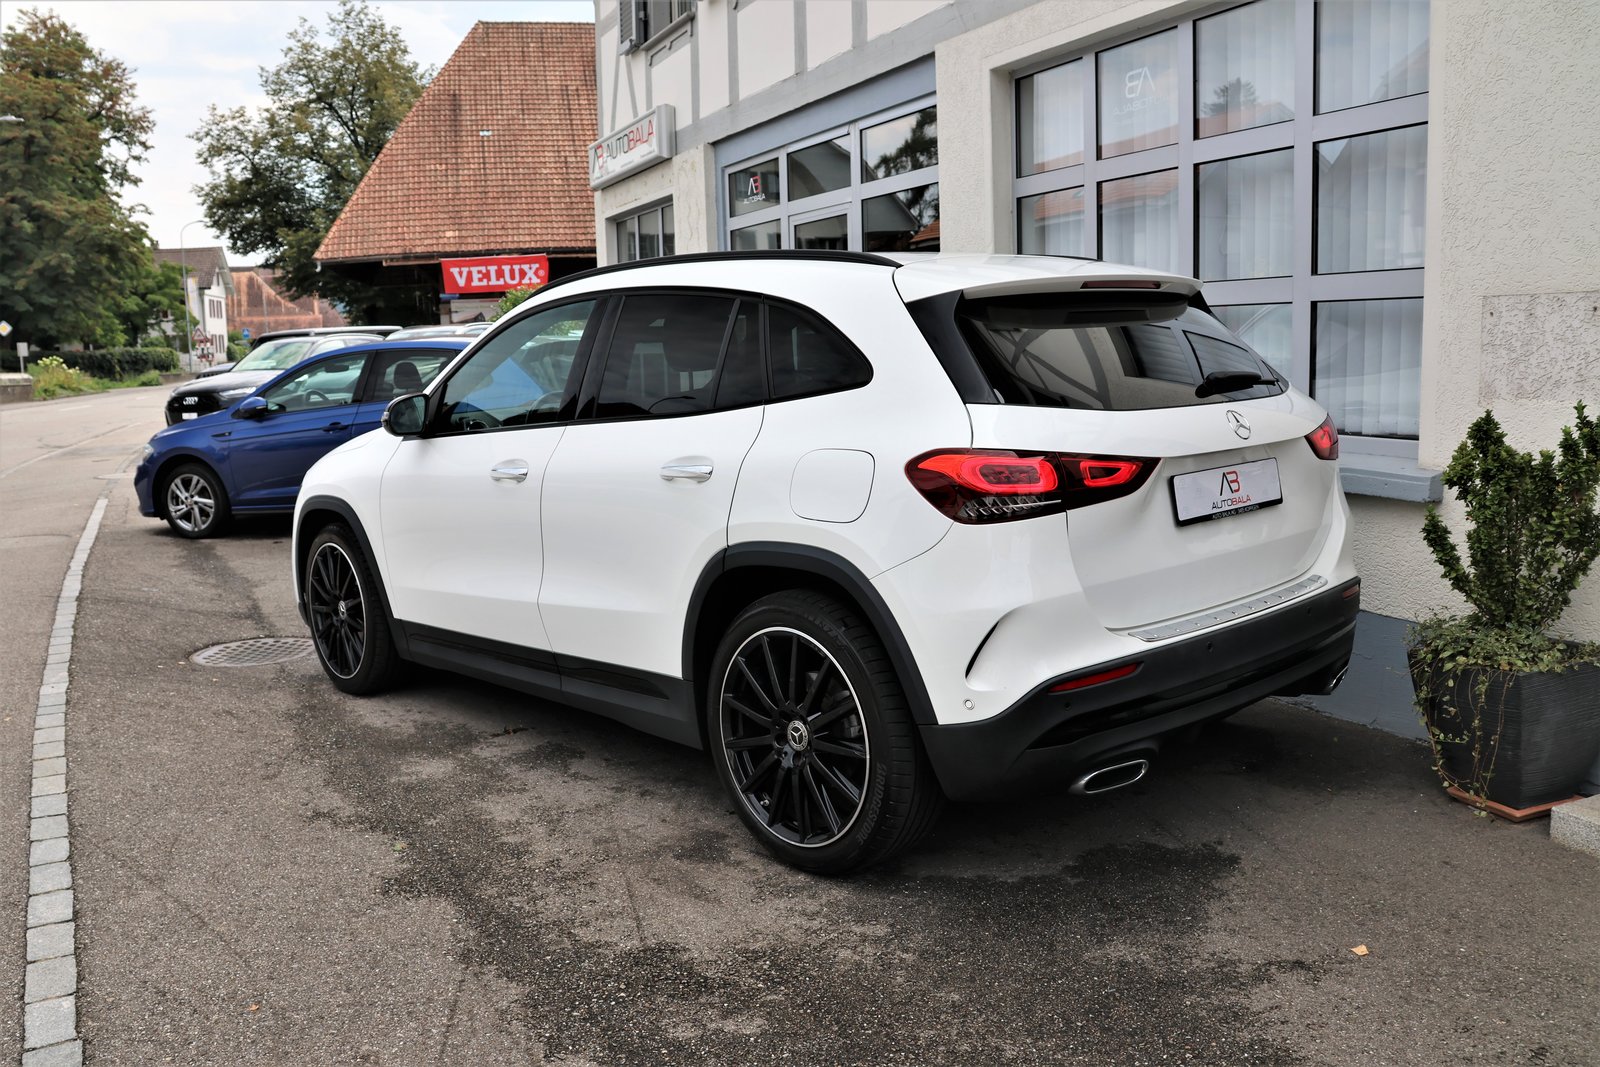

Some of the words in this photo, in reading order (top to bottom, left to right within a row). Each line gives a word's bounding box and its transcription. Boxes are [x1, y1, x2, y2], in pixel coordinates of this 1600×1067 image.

[606, 119, 654, 160] AUTOBALA
[1211, 494, 1252, 510] AUTOBALA
[855, 761, 887, 846] BRIDGESTONE
